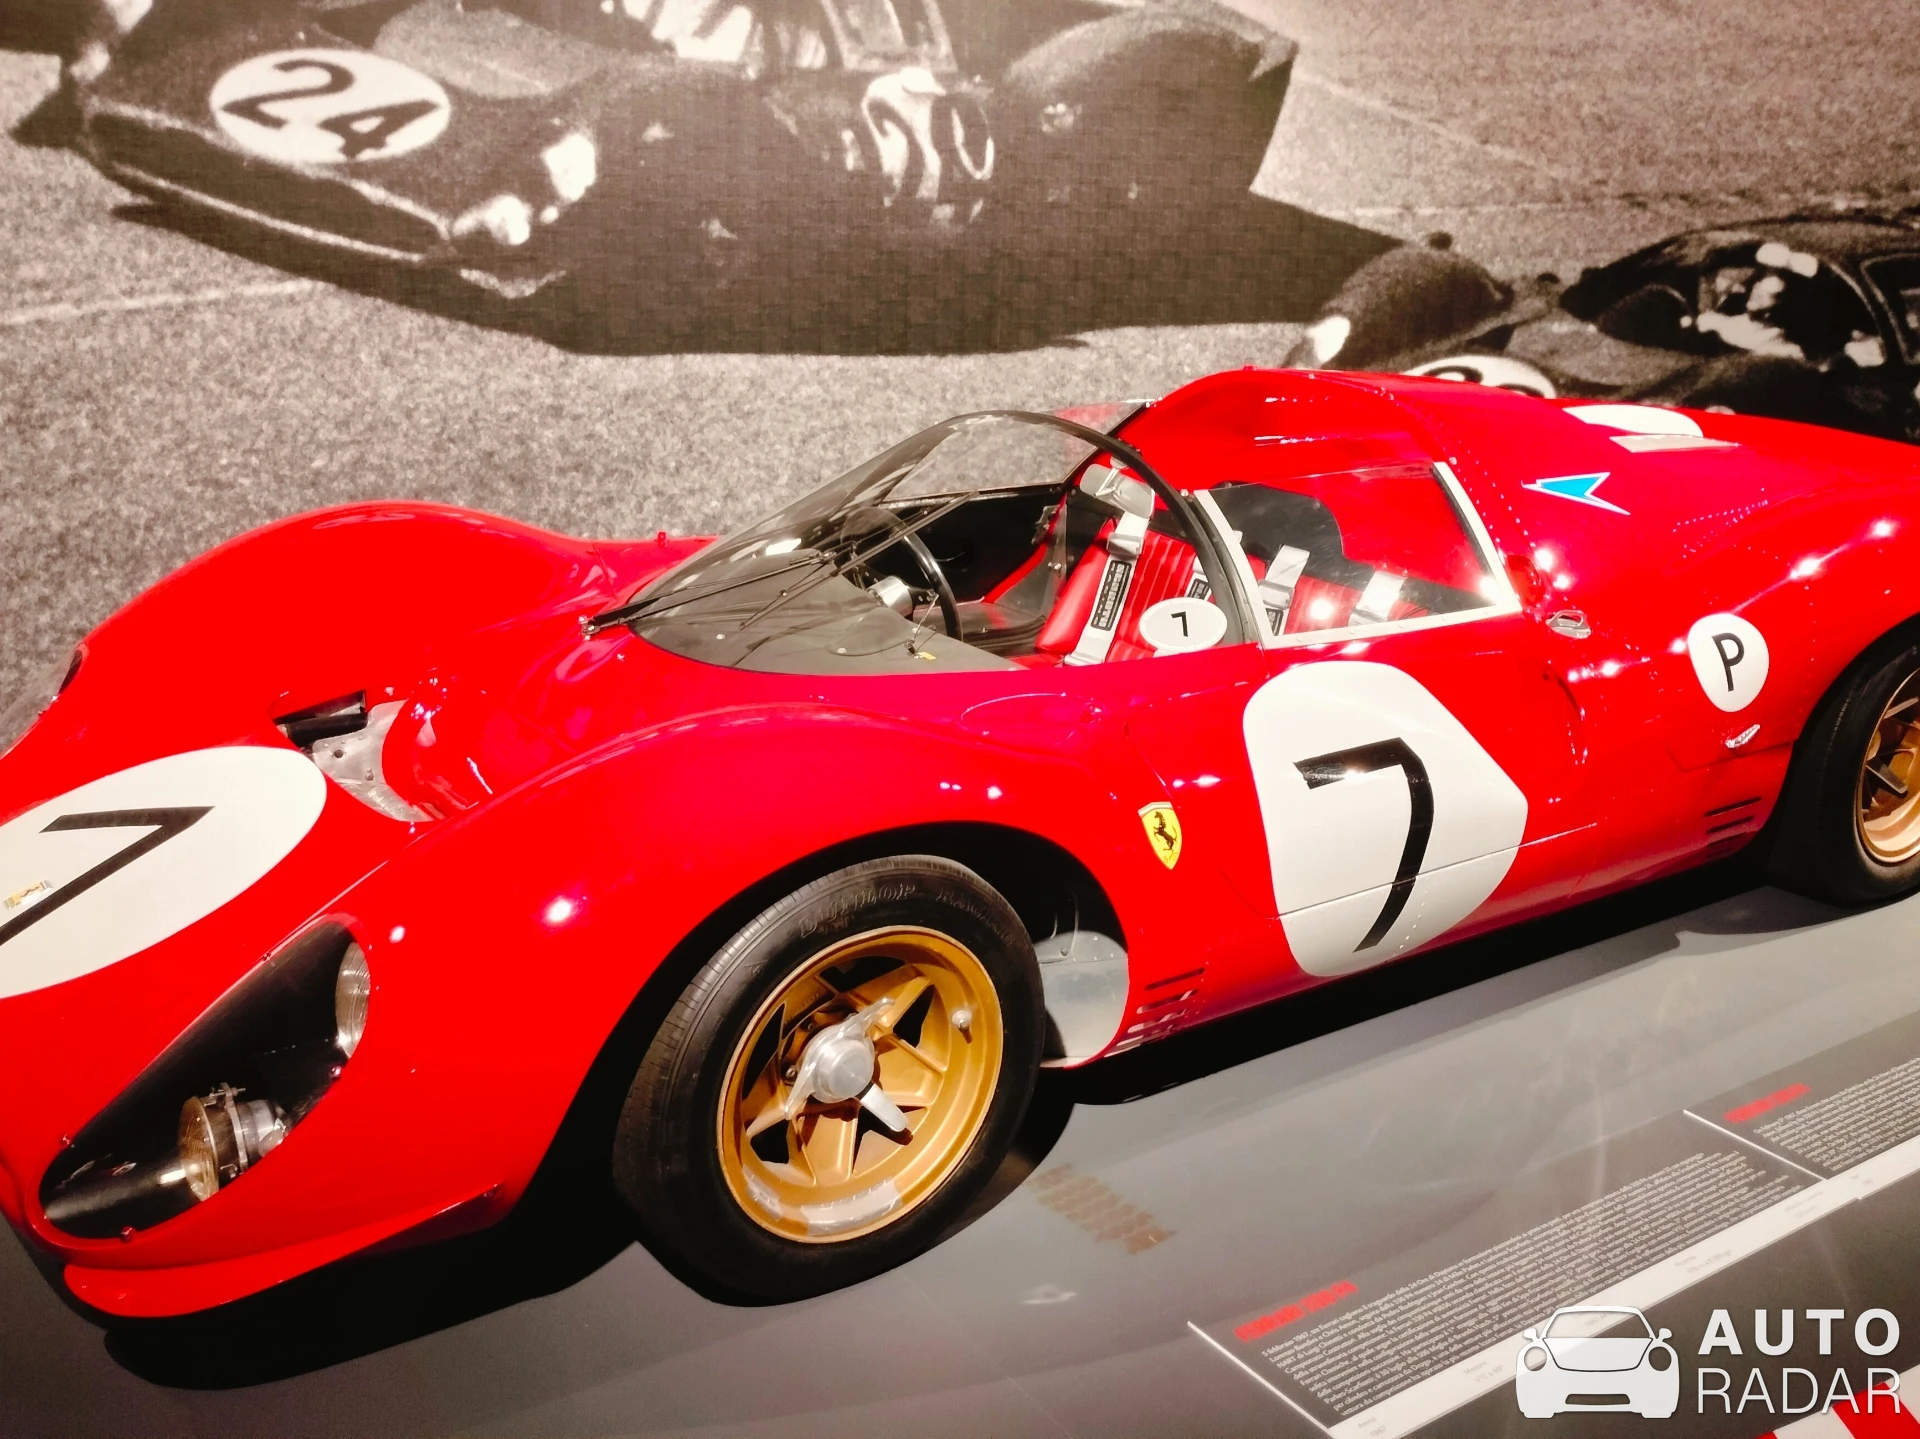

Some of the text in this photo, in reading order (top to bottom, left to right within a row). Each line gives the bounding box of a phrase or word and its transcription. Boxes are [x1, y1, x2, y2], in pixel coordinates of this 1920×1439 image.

[221, 58, 443, 160] 24
[1170, 611, 1188, 638] 7
[1711, 632, 1745, 692] P
[0, 805, 216, 947] 7
[1292, 736, 1435, 953] 7
